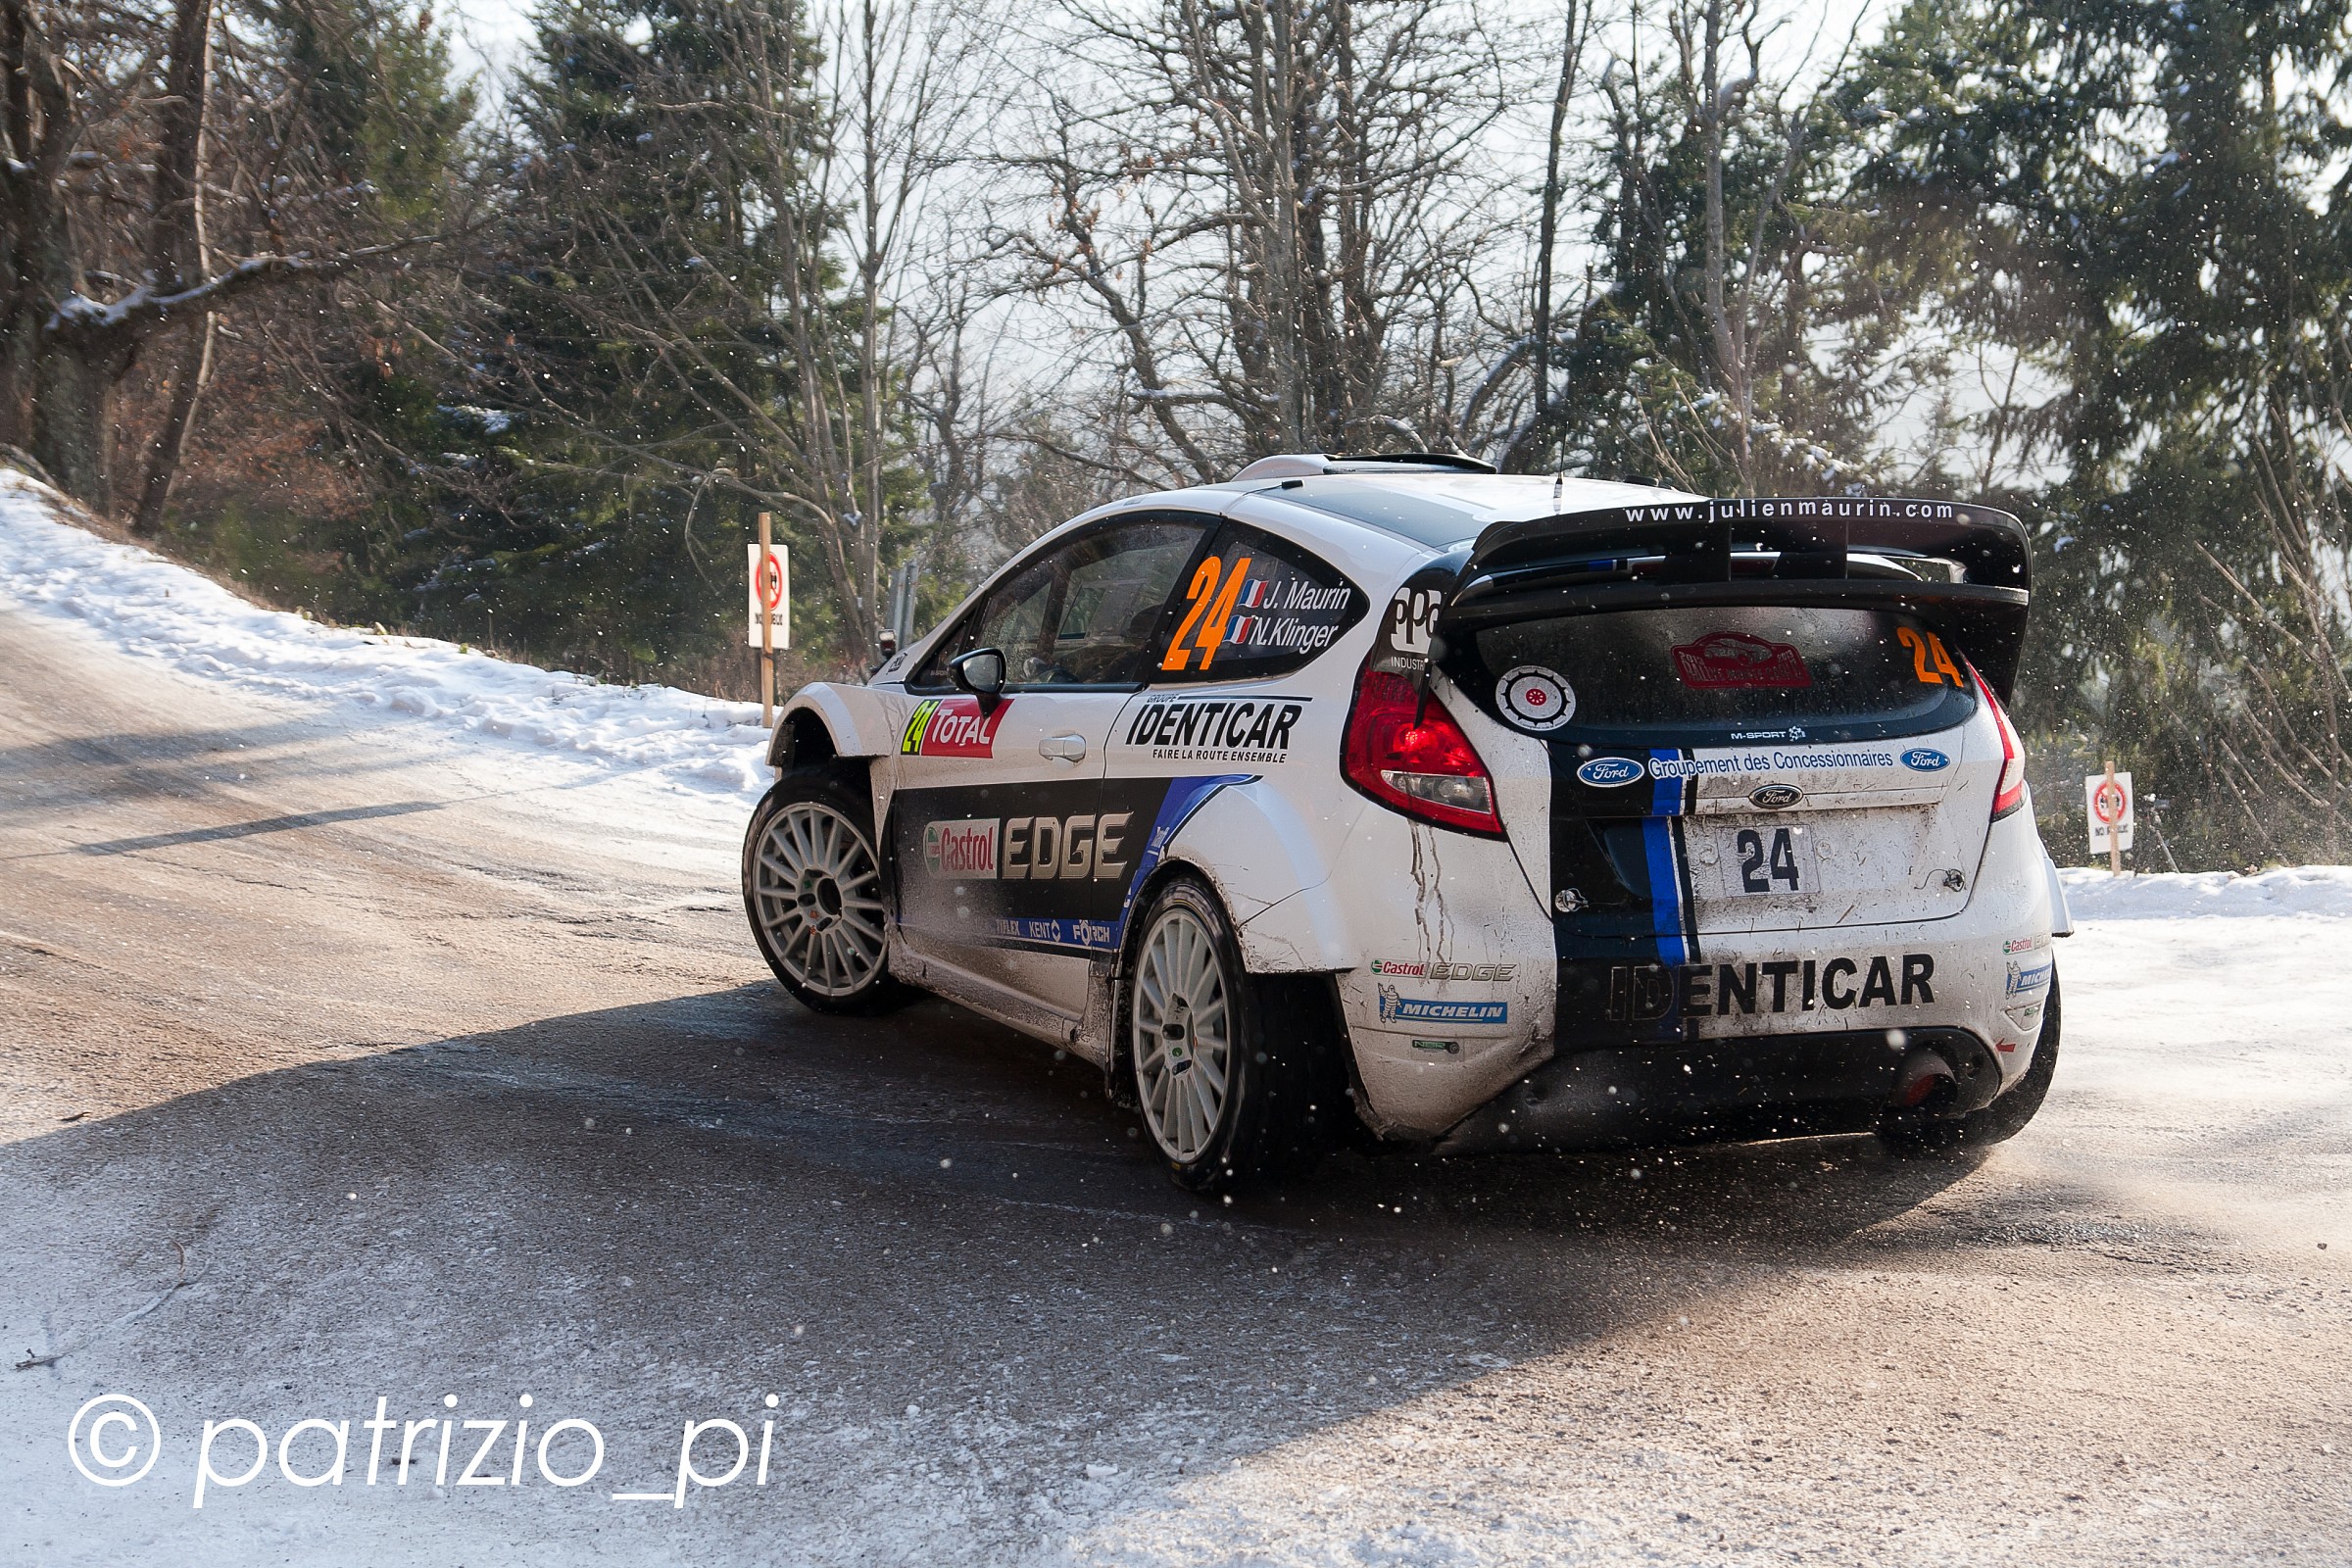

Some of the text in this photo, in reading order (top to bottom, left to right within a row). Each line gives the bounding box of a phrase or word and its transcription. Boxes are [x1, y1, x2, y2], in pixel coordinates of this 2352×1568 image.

[1626, 499, 1953, 523] www.julienmaurin.com
[1283, 581, 1351, 610] Maurin
[1161, 556, 1252, 671] 24
[1896, 627, 1964, 688] 24
[902, 701, 939, 753] 24
[1125, 702, 1303, 751] IDENTICAR
[1731, 731, 1786, 740] M-SPORT
[1152, 749, 1288, 763] FAIRE LA ROUTE ENSEMBLE
[1648, 749, 1893, 780] Groupement des Concessionnaires
[940, 826, 994, 871] Castrol
[1003, 811, 1134, 880] EDGE
[1737, 828, 1799, 893] 24
[1029, 921, 1051, 939] KENT
[2011, 937, 2033, 952] Castrol
[1383, 960, 1517, 982] Castrol EDGE
[1610, 953, 1936, 1021] IDENTICAR
[1402, 1004, 1504, 1018] MICHELIN
